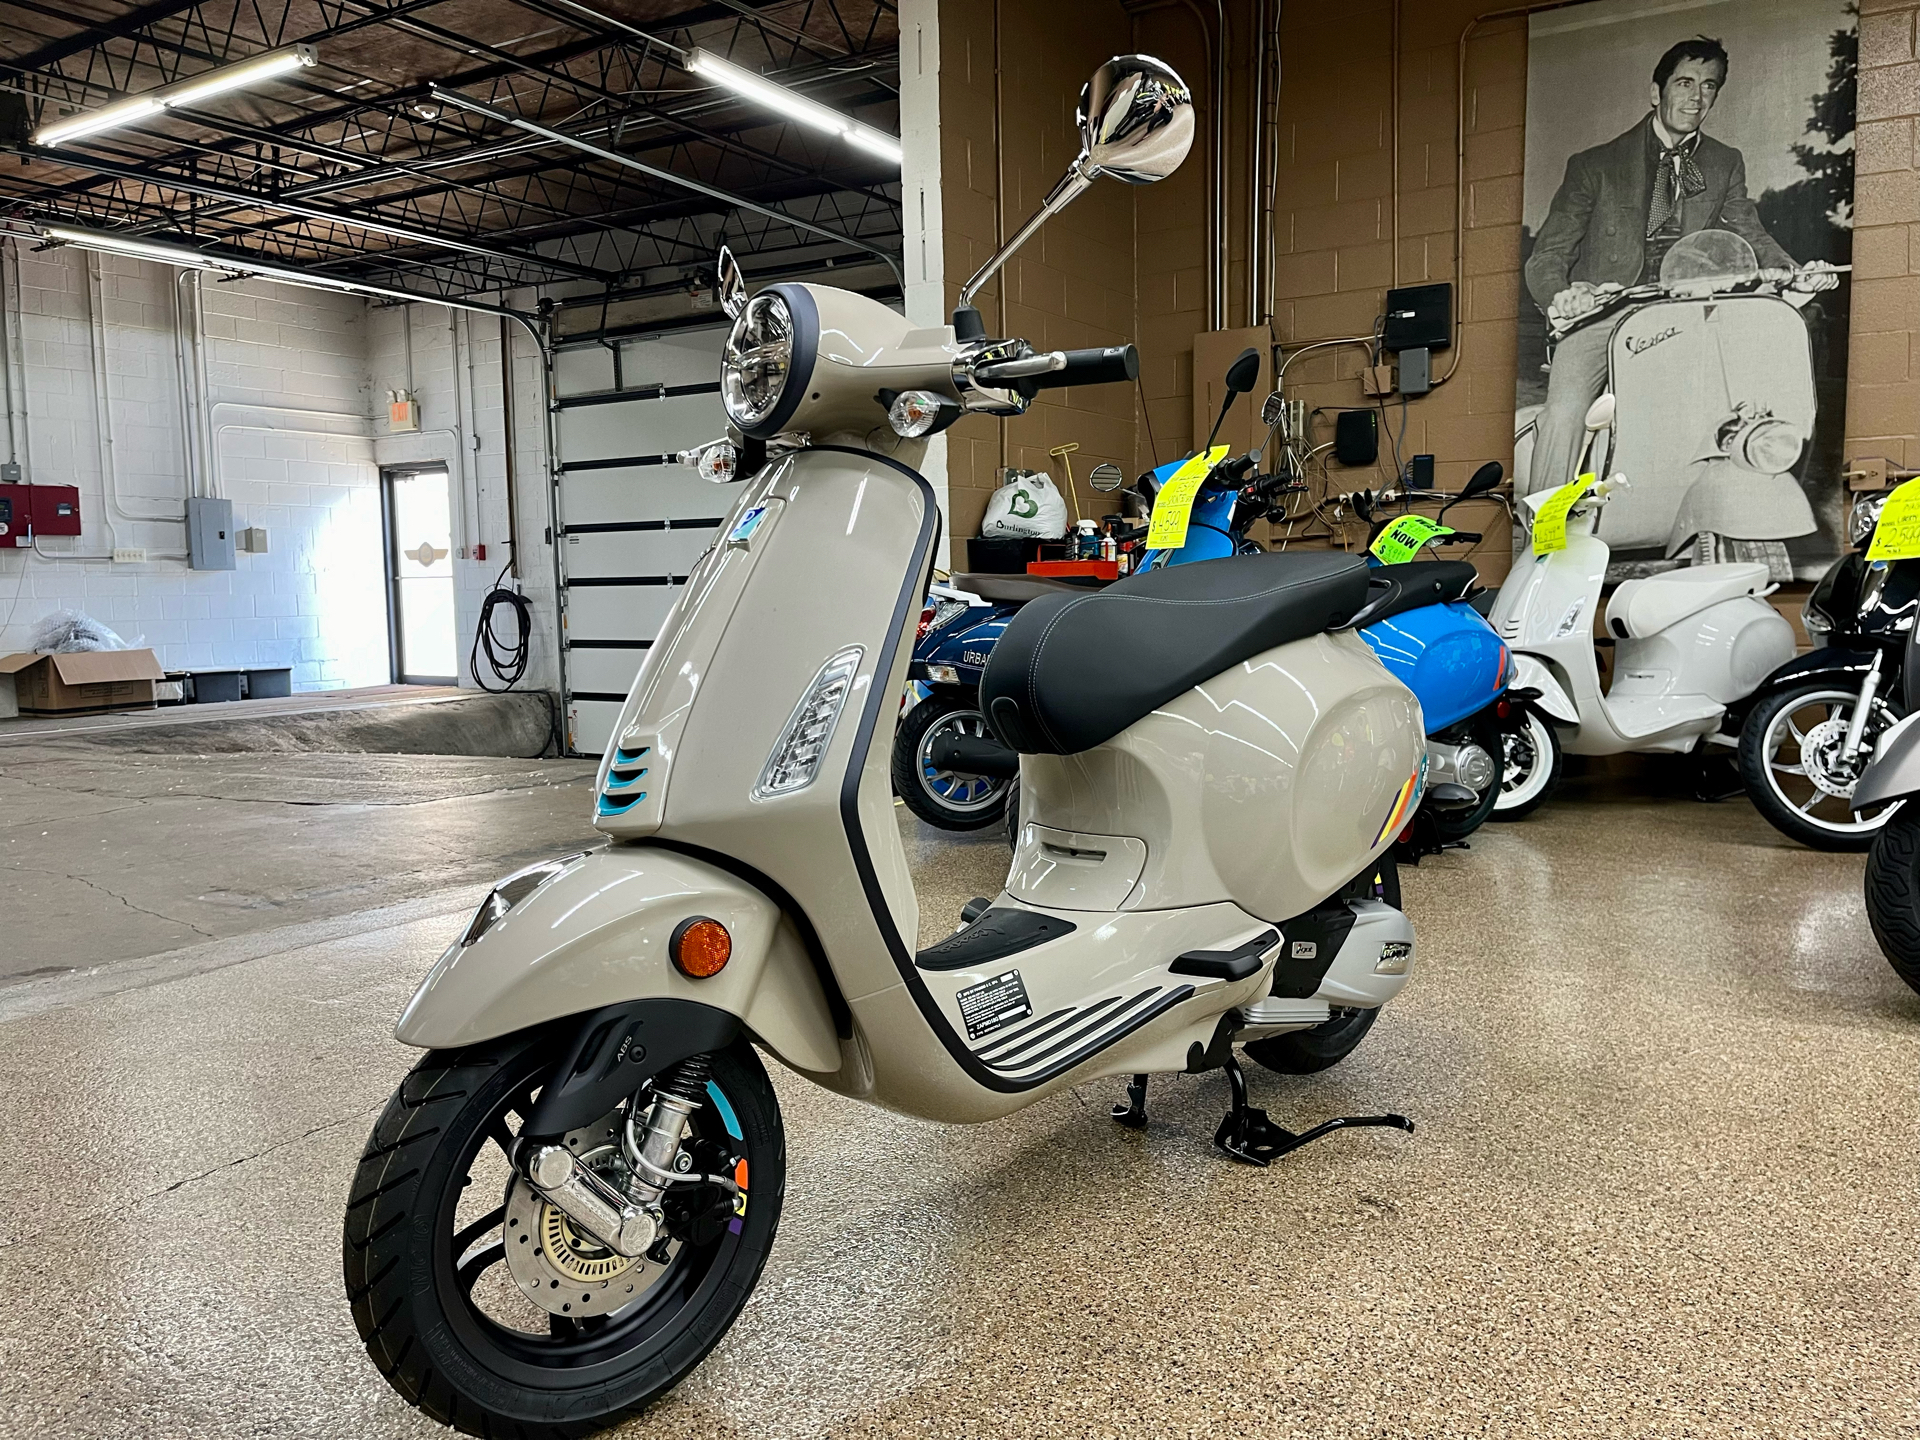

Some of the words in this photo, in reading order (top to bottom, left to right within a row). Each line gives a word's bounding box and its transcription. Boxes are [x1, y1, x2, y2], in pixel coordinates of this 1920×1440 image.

[1625, 326, 1683, 359] Vespa
[392, 402, 408, 421] EXIT
[1390, 529, 1418, 549] NOW
[1379, 545, 1386, 555] $
[617, 1035, 632, 1062] ABS
